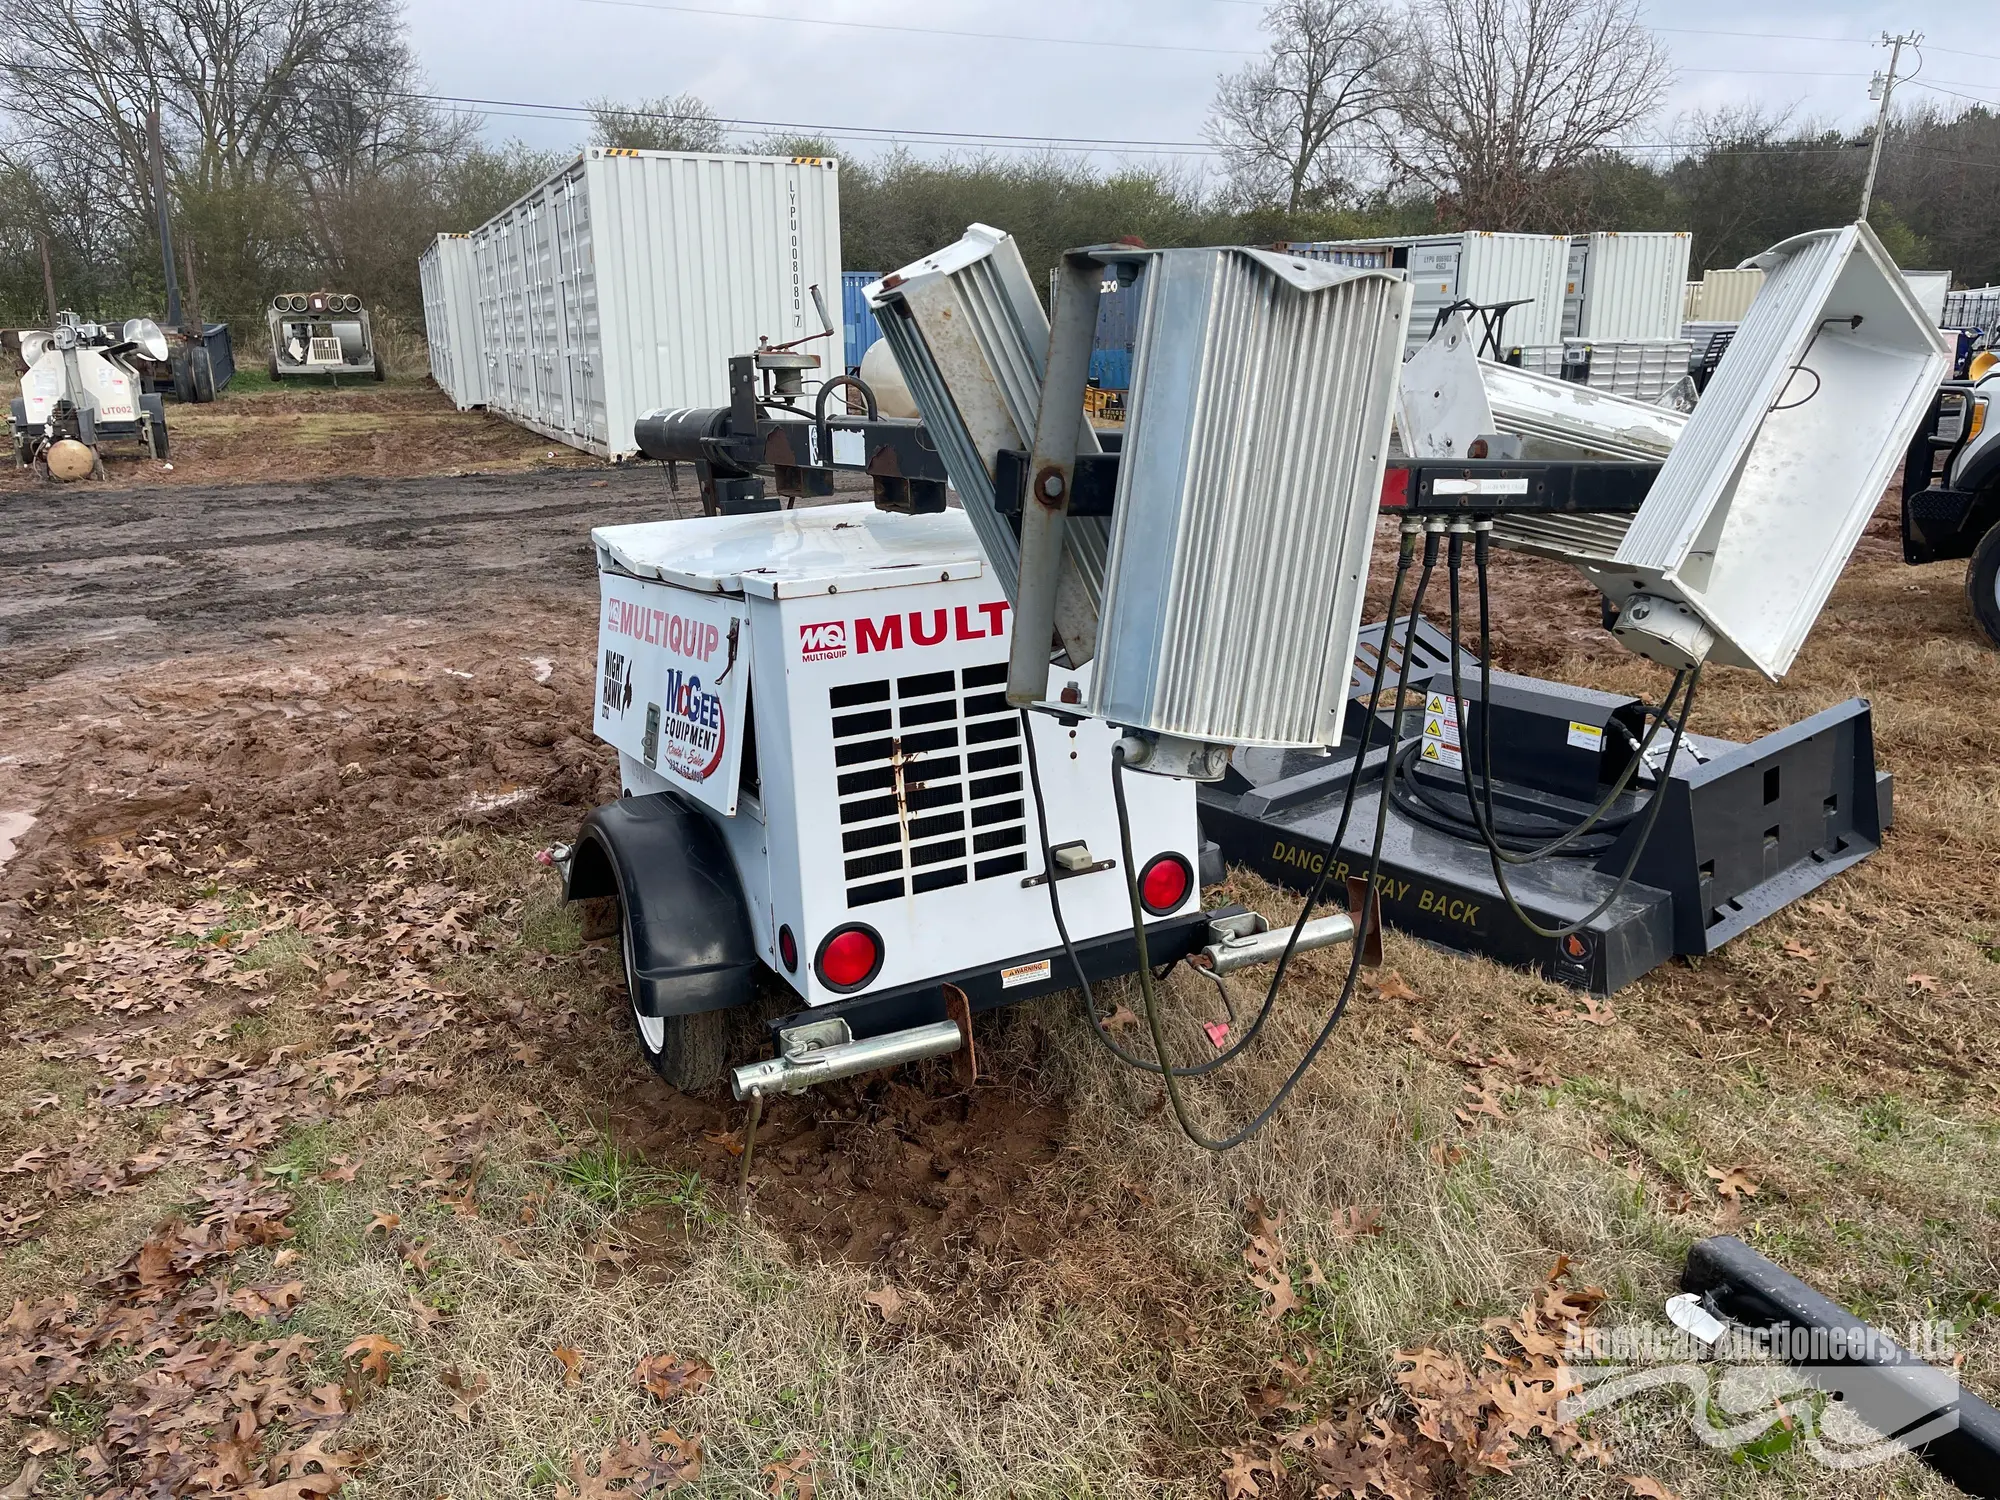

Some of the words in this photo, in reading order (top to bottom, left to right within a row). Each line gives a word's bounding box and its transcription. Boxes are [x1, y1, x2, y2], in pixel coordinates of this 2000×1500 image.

[789, 180, 797, 232] LYPU
[791, 235, 800, 310] 008080
[102, 406, 132, 415] LIT002
[620, 601, 719, 662] MULTIQUIP
[800, 621, 847, 653] MQ
[855, 600, 1011, 655] MULT
[604, 649, 625, 683] NIGHT
[802, 650, 847, 663] MULTIQUIP
[603, 675, 622, 712] HAWK
[665, 716, 717, 753] EQUIPMENT
[1272, 841, 1350, 882] DANGER
[1419, 889, 1481, 927] BACK
[1014, 963, 1043, 975] WARNING
